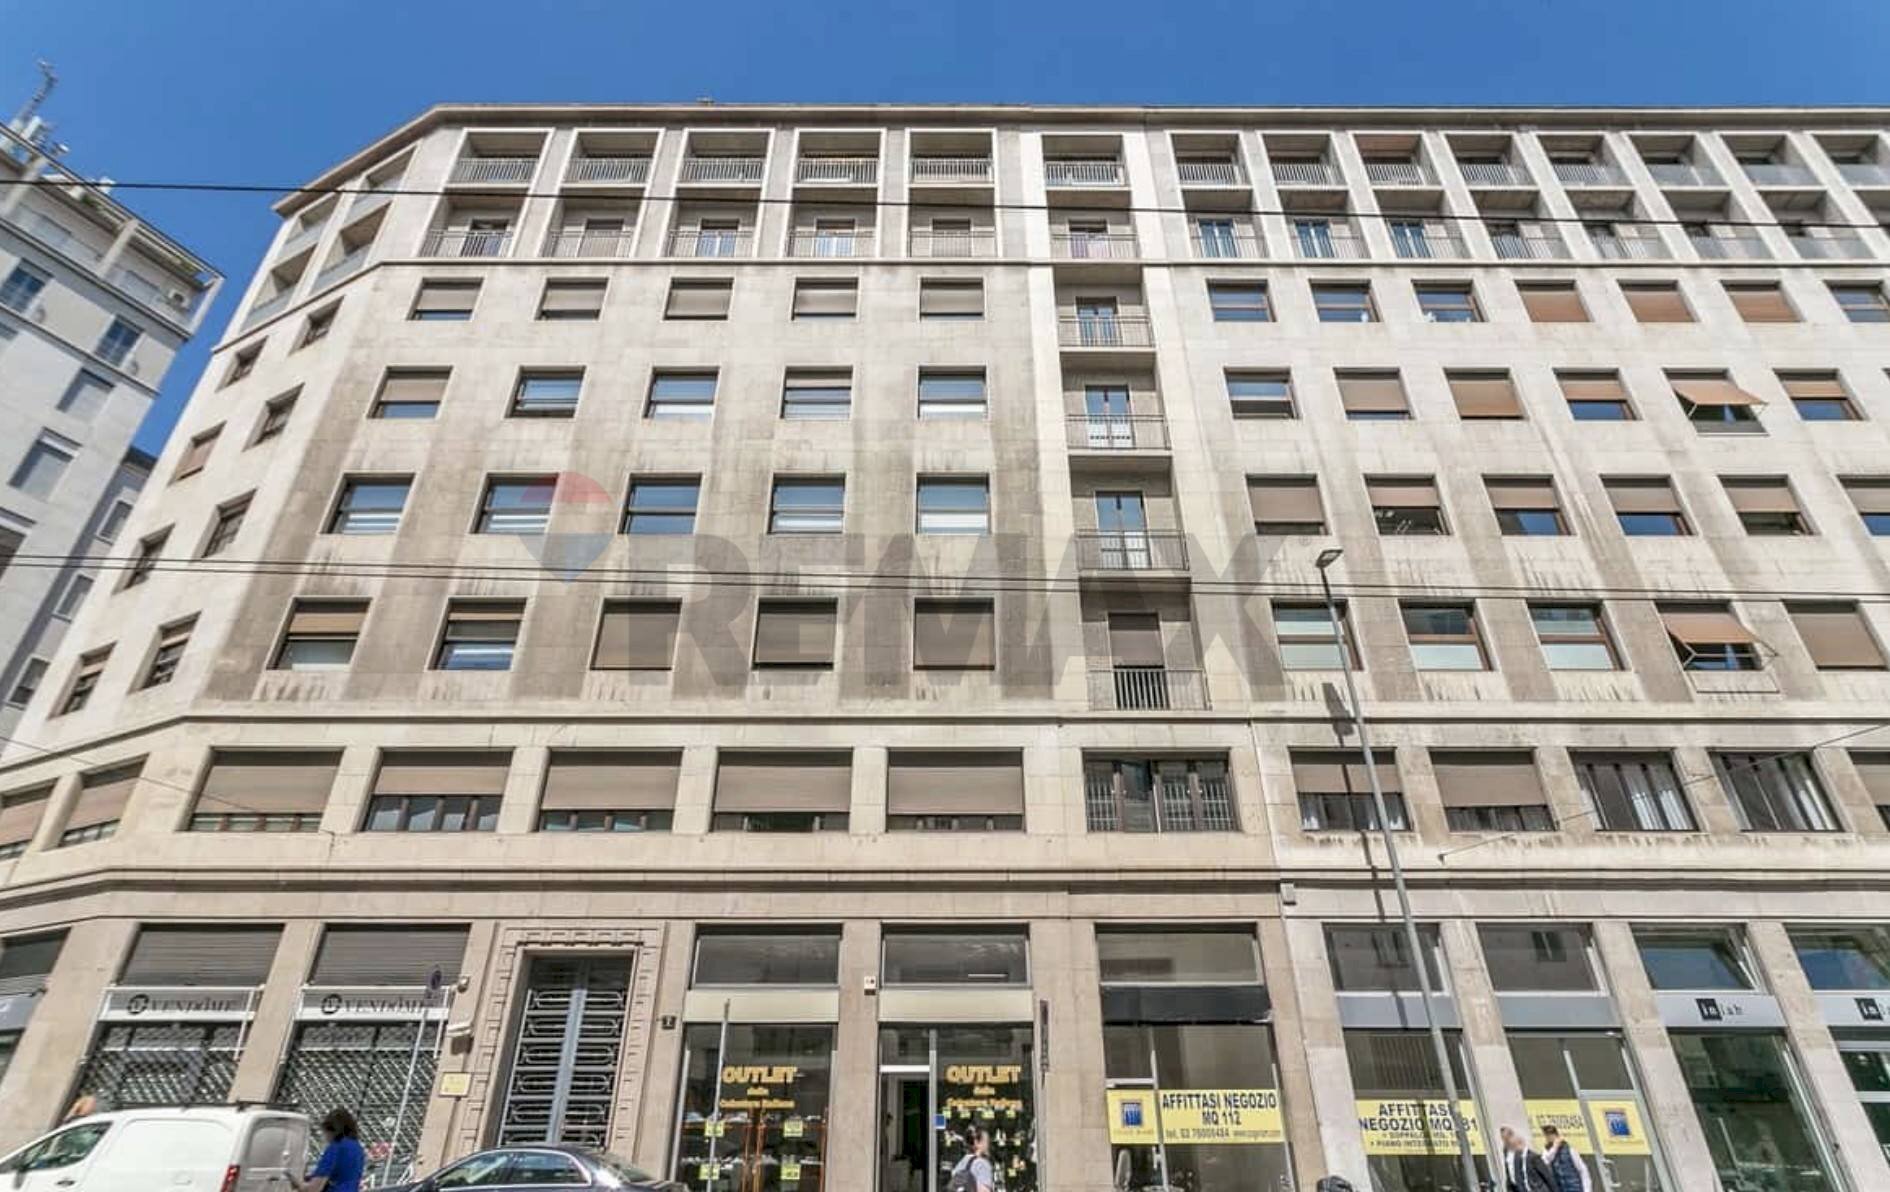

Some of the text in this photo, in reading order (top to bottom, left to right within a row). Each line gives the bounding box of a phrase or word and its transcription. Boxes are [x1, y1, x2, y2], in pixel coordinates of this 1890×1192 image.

[723, 1065, 798, 1084] OUTLET
[946, 1064, 1022, 1084] OUTLET
[1163, 1093, 1277, 1109] AFFITTASI NEGOZIO
[1202, 1111, 1241, 1125] MQ 112
[1359, 1118, 1425, 1131] NEGOZIO
